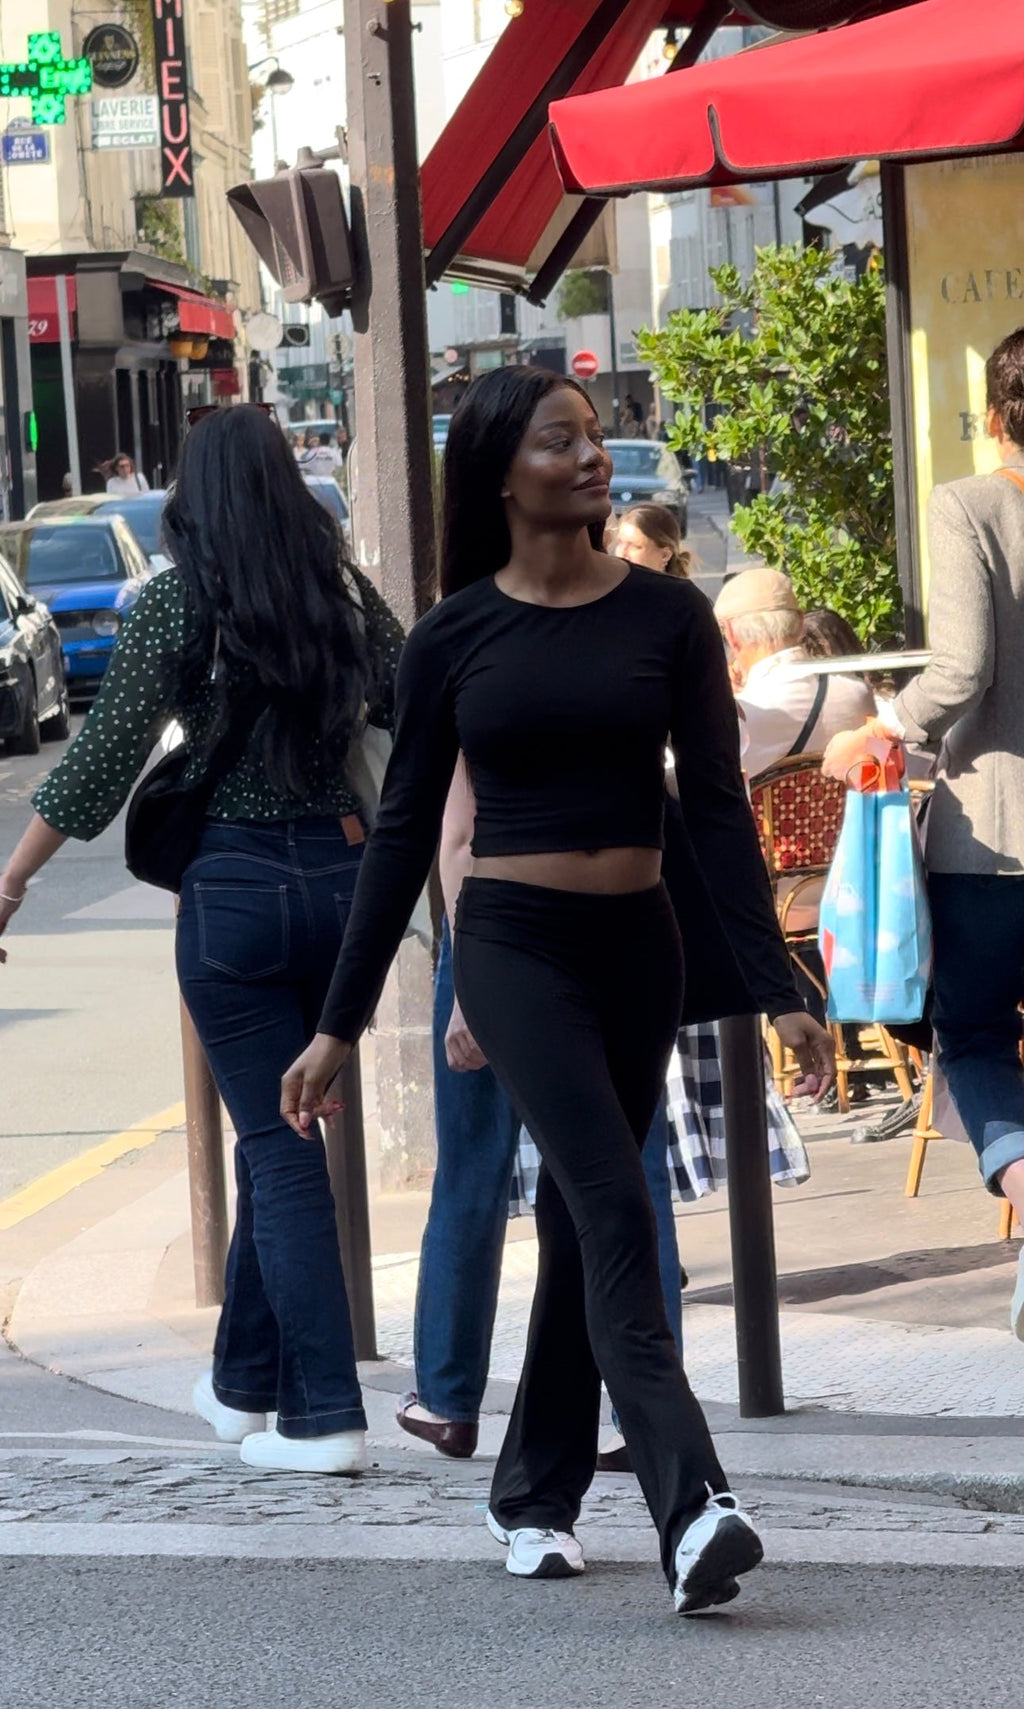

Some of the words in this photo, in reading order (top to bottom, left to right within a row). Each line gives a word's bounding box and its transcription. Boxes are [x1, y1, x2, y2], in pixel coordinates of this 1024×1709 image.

[91, 99, 153, 118] LAVERIE
[119, 118, 153, 131] SERVICE
[14, 136, 32, 144] RUE
[24, 143, 36, 151] LA
[28, 319, 49, 337] 79
